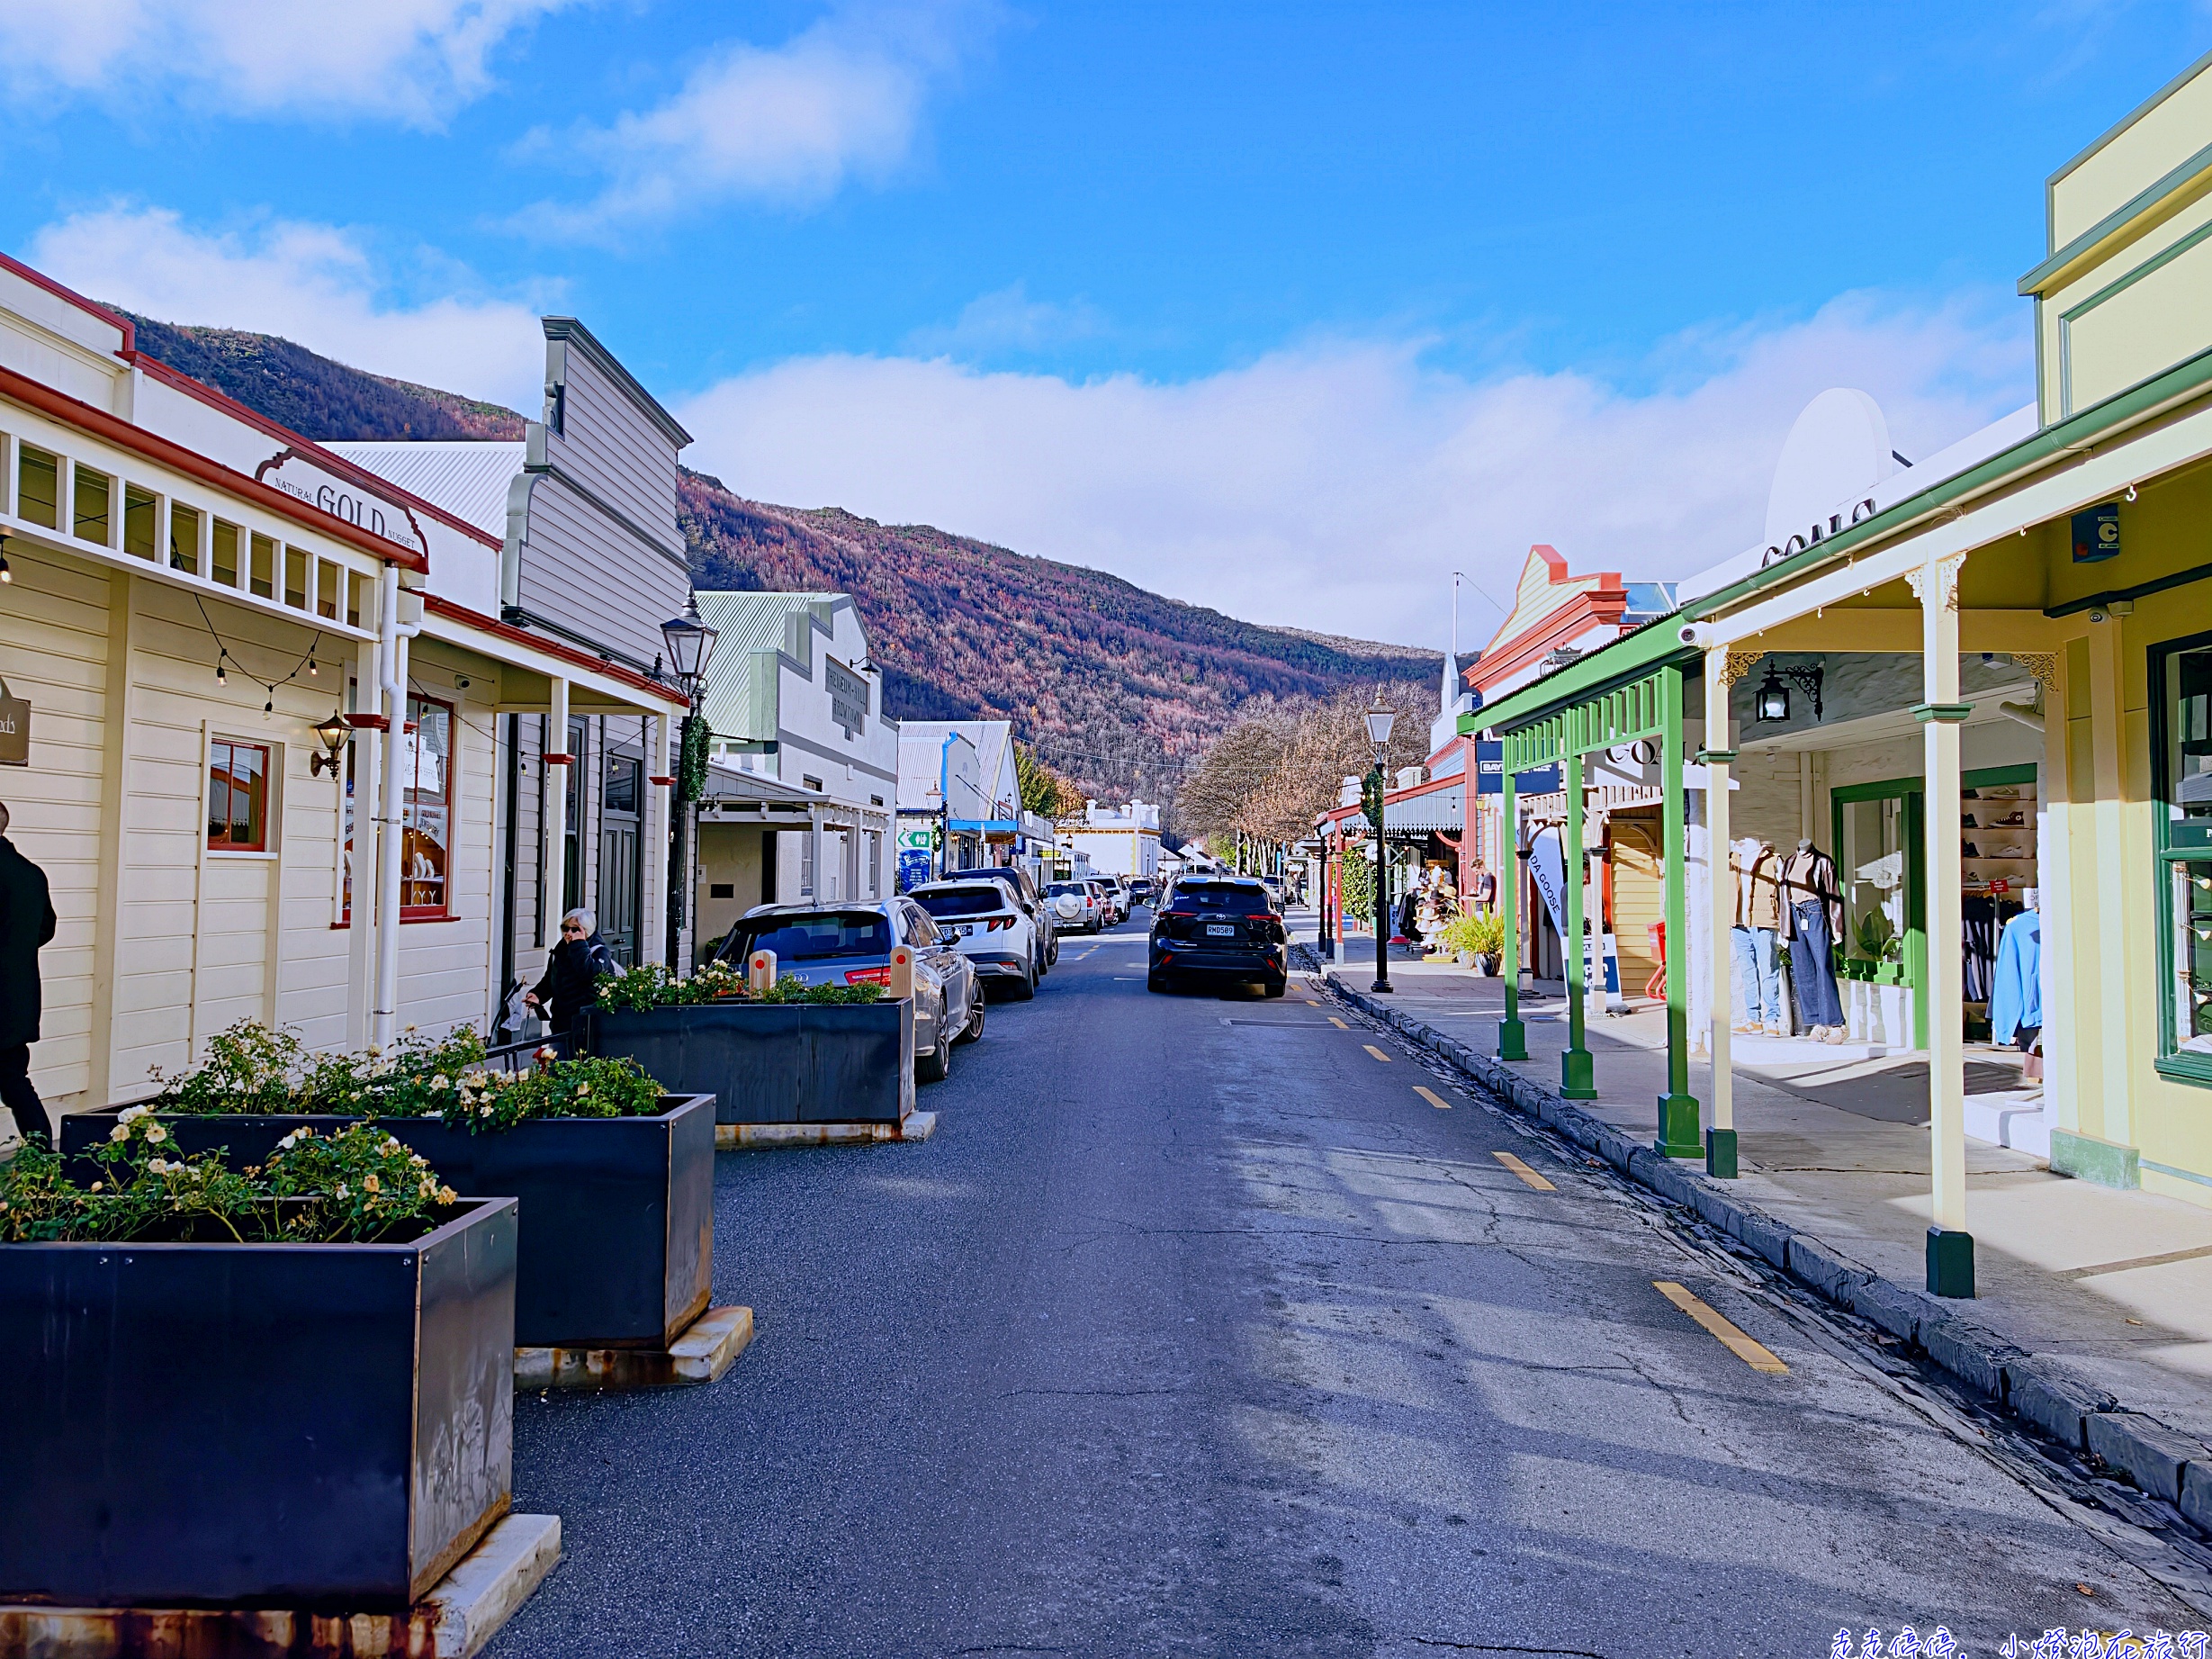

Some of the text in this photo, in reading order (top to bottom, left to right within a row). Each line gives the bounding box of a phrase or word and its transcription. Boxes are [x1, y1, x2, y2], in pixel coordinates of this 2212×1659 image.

[274, 477, 314, 504] NATURAL
[388, 529, 415, 549] NUGGET
[1539, 873, 1560, 914] GOOSE
